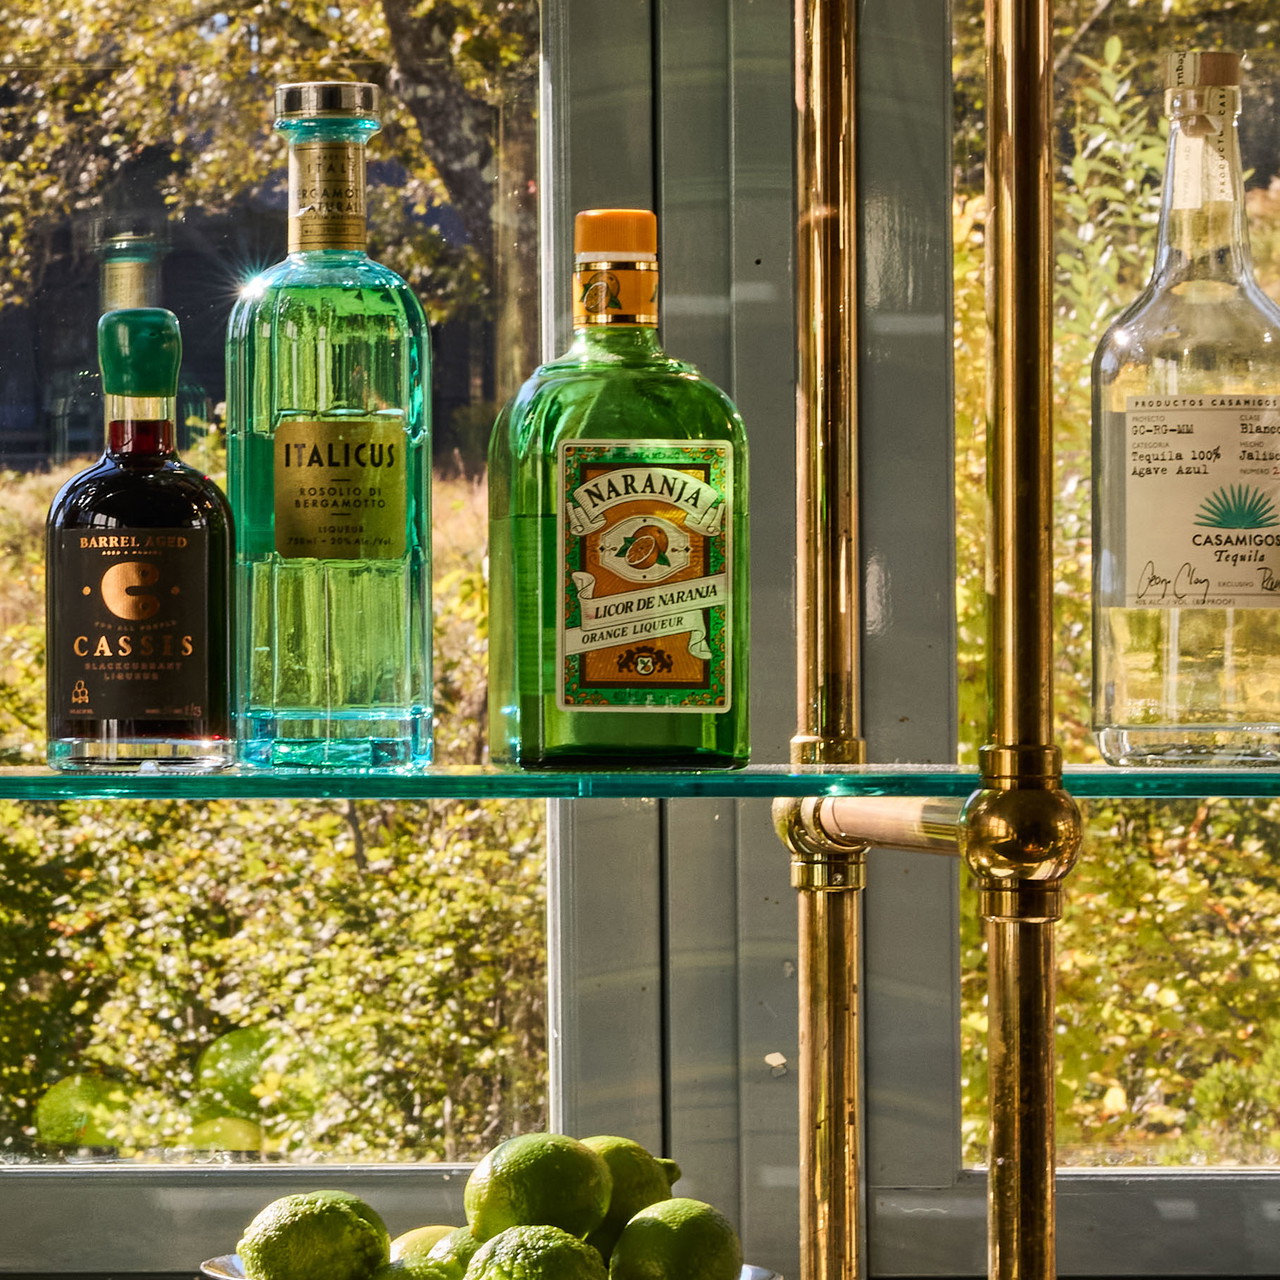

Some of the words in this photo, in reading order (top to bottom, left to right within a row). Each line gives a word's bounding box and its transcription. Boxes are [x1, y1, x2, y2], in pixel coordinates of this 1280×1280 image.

[1134, 399, 1204, 408] PRODUCTOS
[1211, 398, 1278, 407] CASAMIGOS
[1131, 424, 1194, 435] GC-RG-MM
[284, 442, 395, 468] ITALICUS
[1131, 450, 1183, 464] Tequila
[1191, 445, 1221, 463] 100%
[1131, 465, 1168, 477] Agave
[1176, 464, 1209, 475] Azul
[299, 487, 362, 497] ROSOLIO
[369, 487, 382, 497] DI
[583, 473, 703, 509] NARANJA
[294, 499, 386, 509] BERGAMOTTO
[317, 525, 364, 534] LIQUEUR
[79, 535, 140, 549] BARREL
[143, 535, 188, 548] AGED
[1214, 549, 1265, 566] Tequila
[594, 600, 634, 620] LICOR
[636, 596, 656, 612] DE
[657, 583, 719, 608] NARANJA
[581, 626, 629, 645] ORANGE
[632, 616, 684, 636] LIQUEUR
[73, 635, 193, 657] CASSIS
[85, 662, 183, 670] BLACKCURRANT
[104, 672, 159, 680] LIQUEUR
